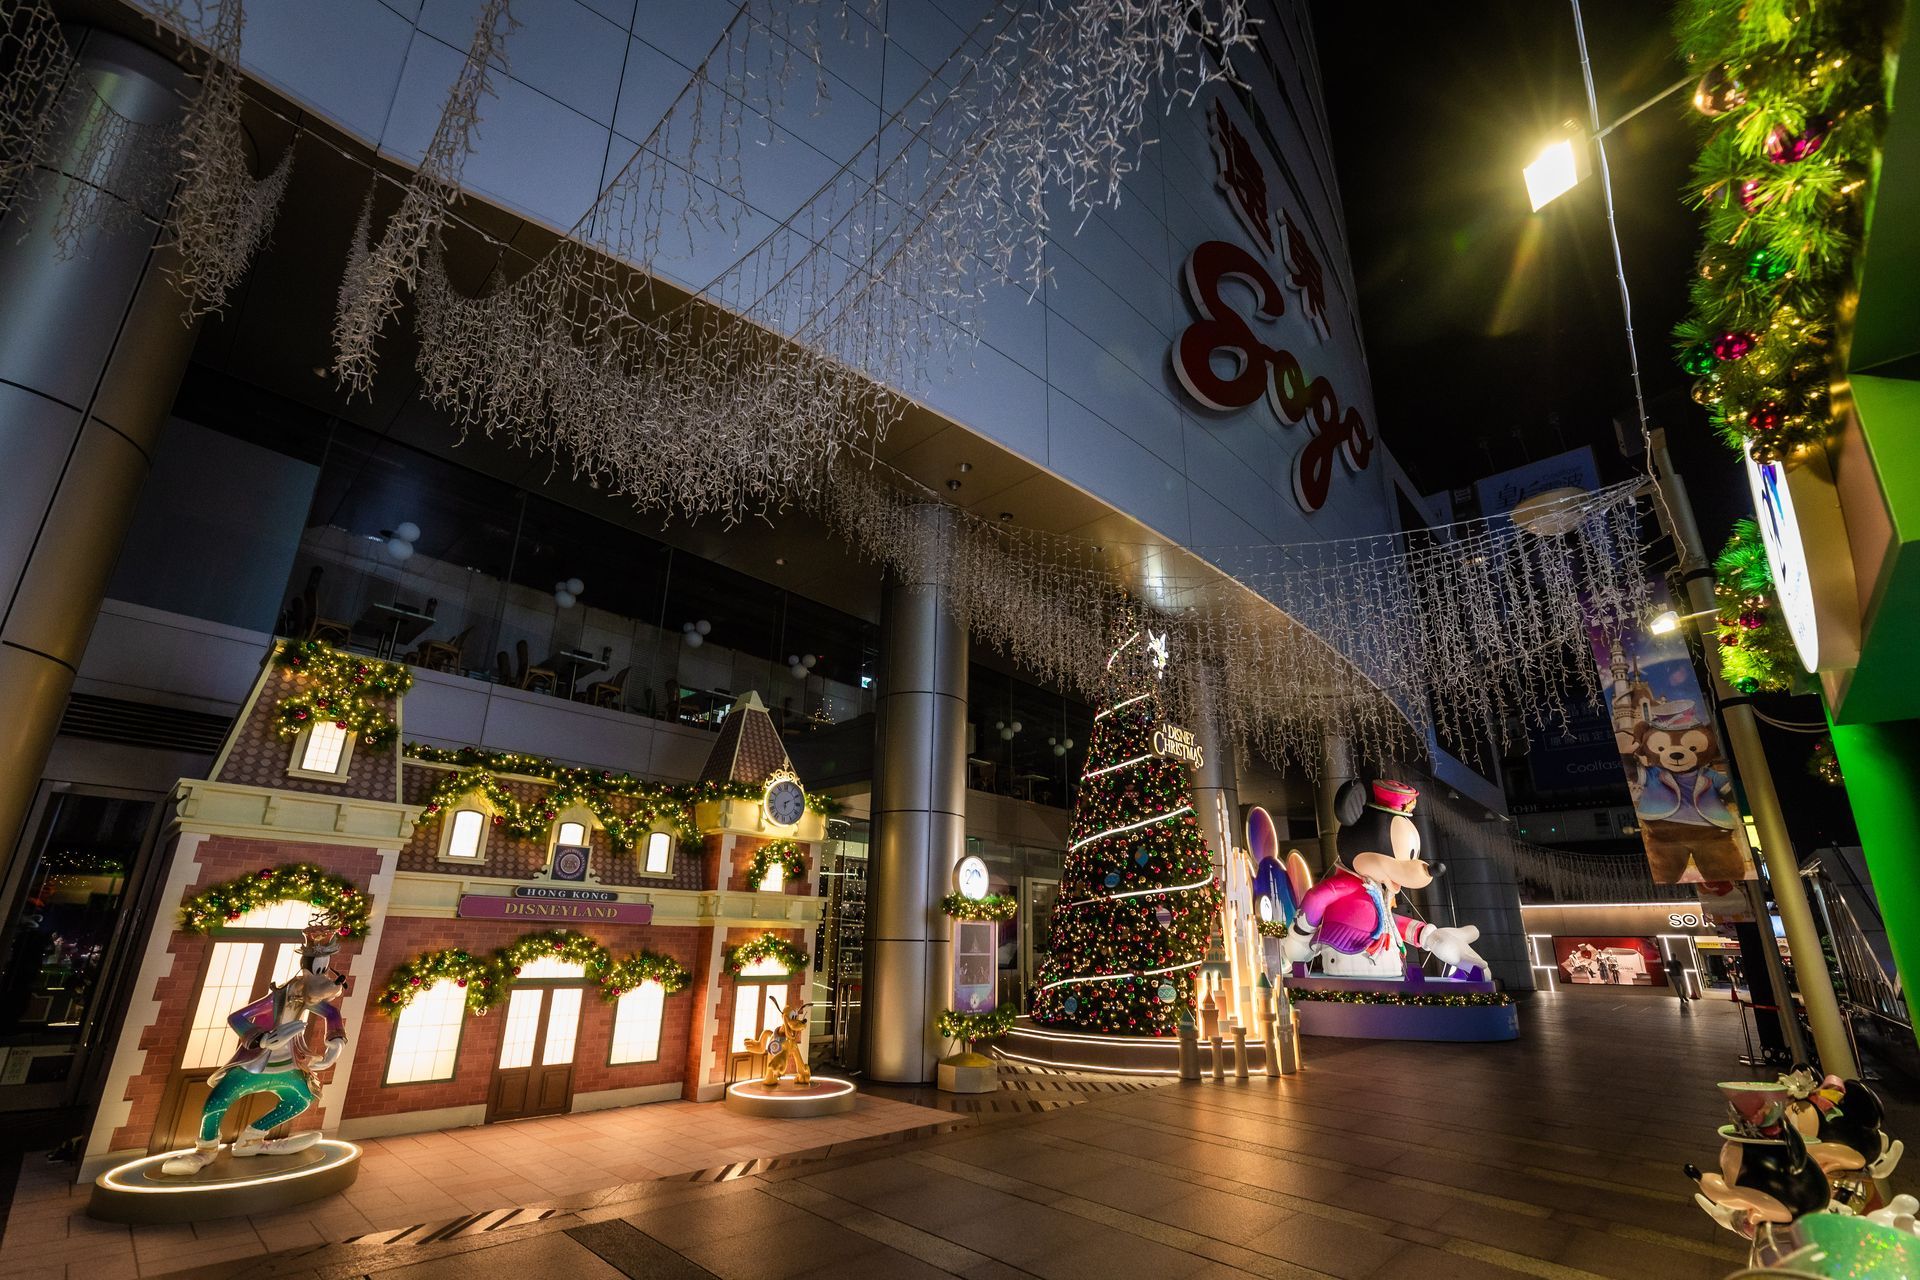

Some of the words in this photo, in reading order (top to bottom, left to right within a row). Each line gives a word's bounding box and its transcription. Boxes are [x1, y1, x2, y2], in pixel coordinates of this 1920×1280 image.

[1167, 724, 1195, 747] DISNEY
[1153, 730, 1204, 769] CHRISTMAS
[526, 888, 566, 898] HONG
[572, 891, 608, 900] KONG
[504, 902, 618, 918] DISNEYLAND
[1669, 913, 1698, 927] SO
